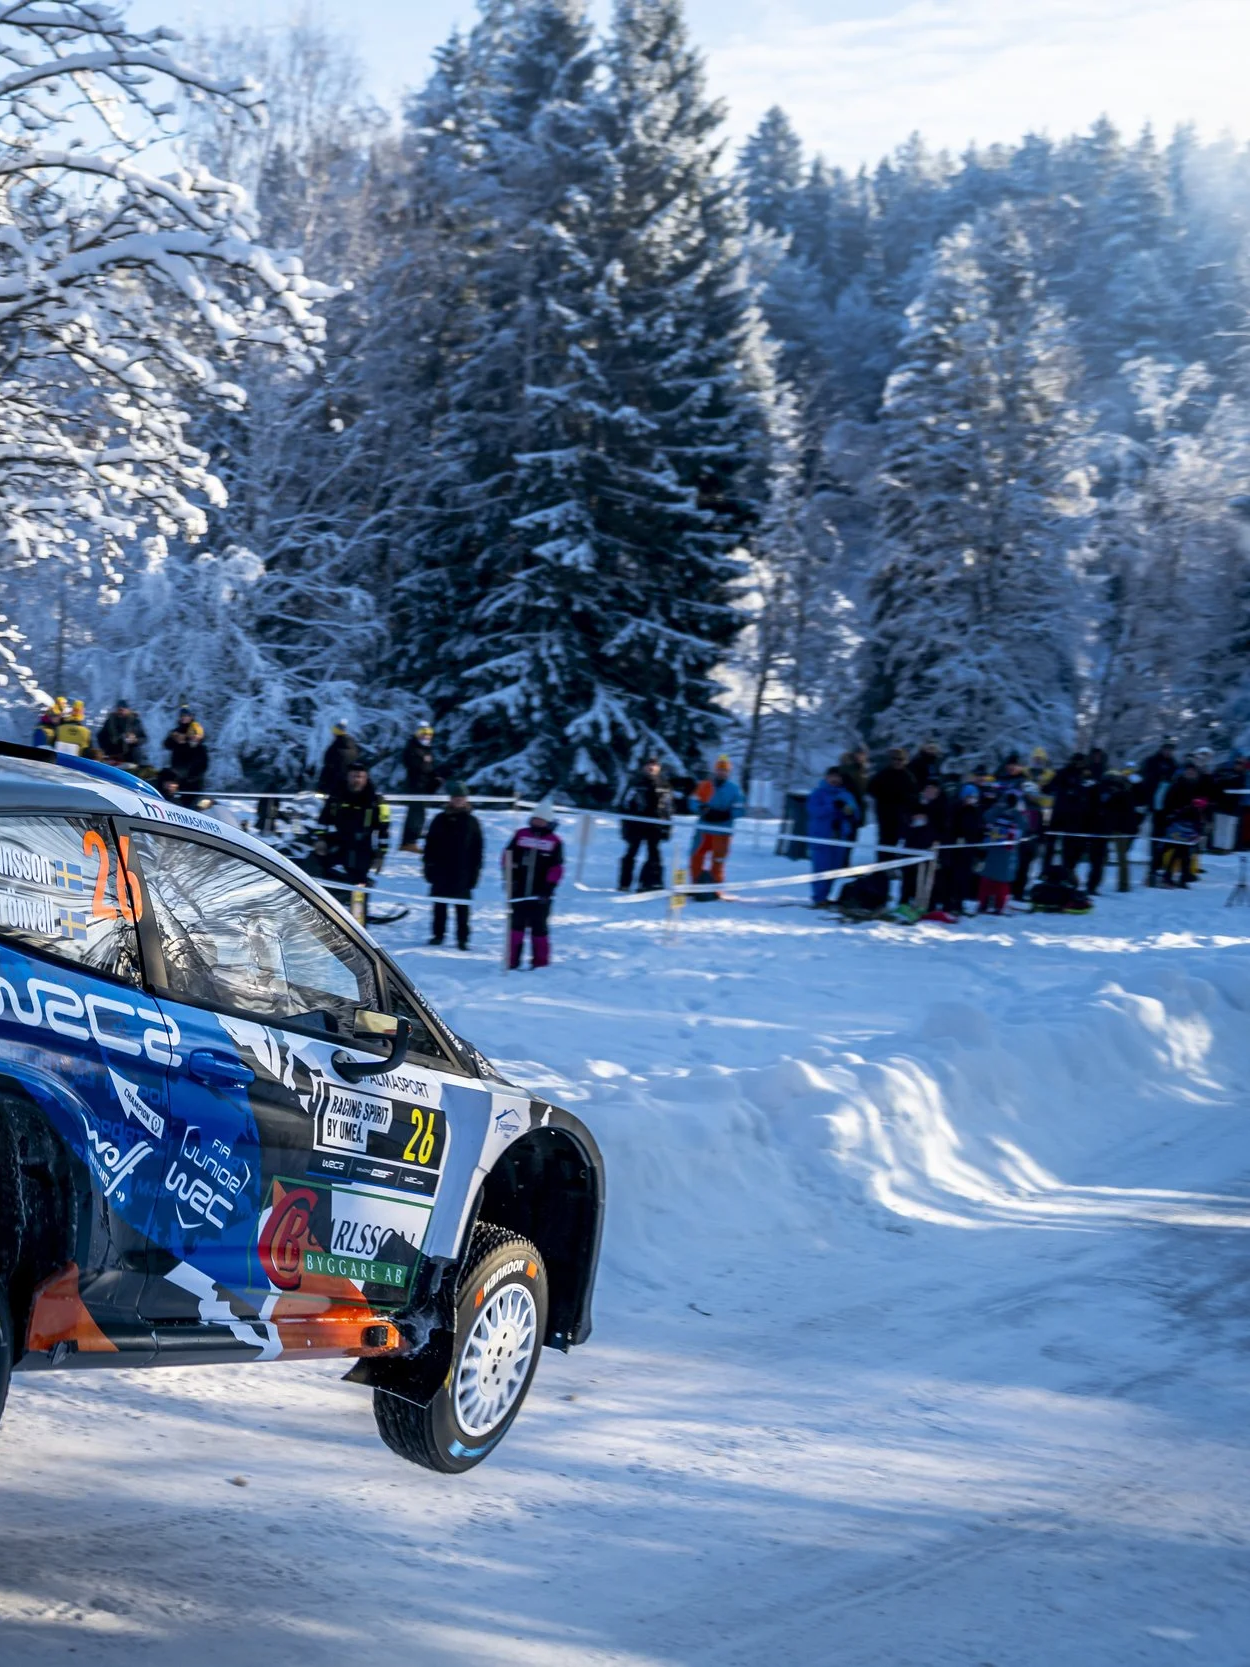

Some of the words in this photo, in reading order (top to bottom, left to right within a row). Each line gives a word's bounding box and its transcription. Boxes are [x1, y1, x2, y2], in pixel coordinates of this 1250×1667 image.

[165, 810, 222, 834] HYRMASKINER
[83, 830, 143, 923] 26
[360, 1074, 430, 1098] ALMASPORT
[124, 1088, 151, 1123] CHAMPION
[330, 1096, 362, 1120] RACING
[363, 1102, 389, 1126] SPIRIT
[327, 1118, 338, 1138] BY
[403, 1108, 436, 1165] 26
[212, 1138, 231, 1160] FIA
[184, 1145, 241, 1194] JUNIOR
[165, 1161, 234, 1229] WRC
[306, 1254, 376, 1280] BYGGARE
[384, 1269, 402, 1284] AB
